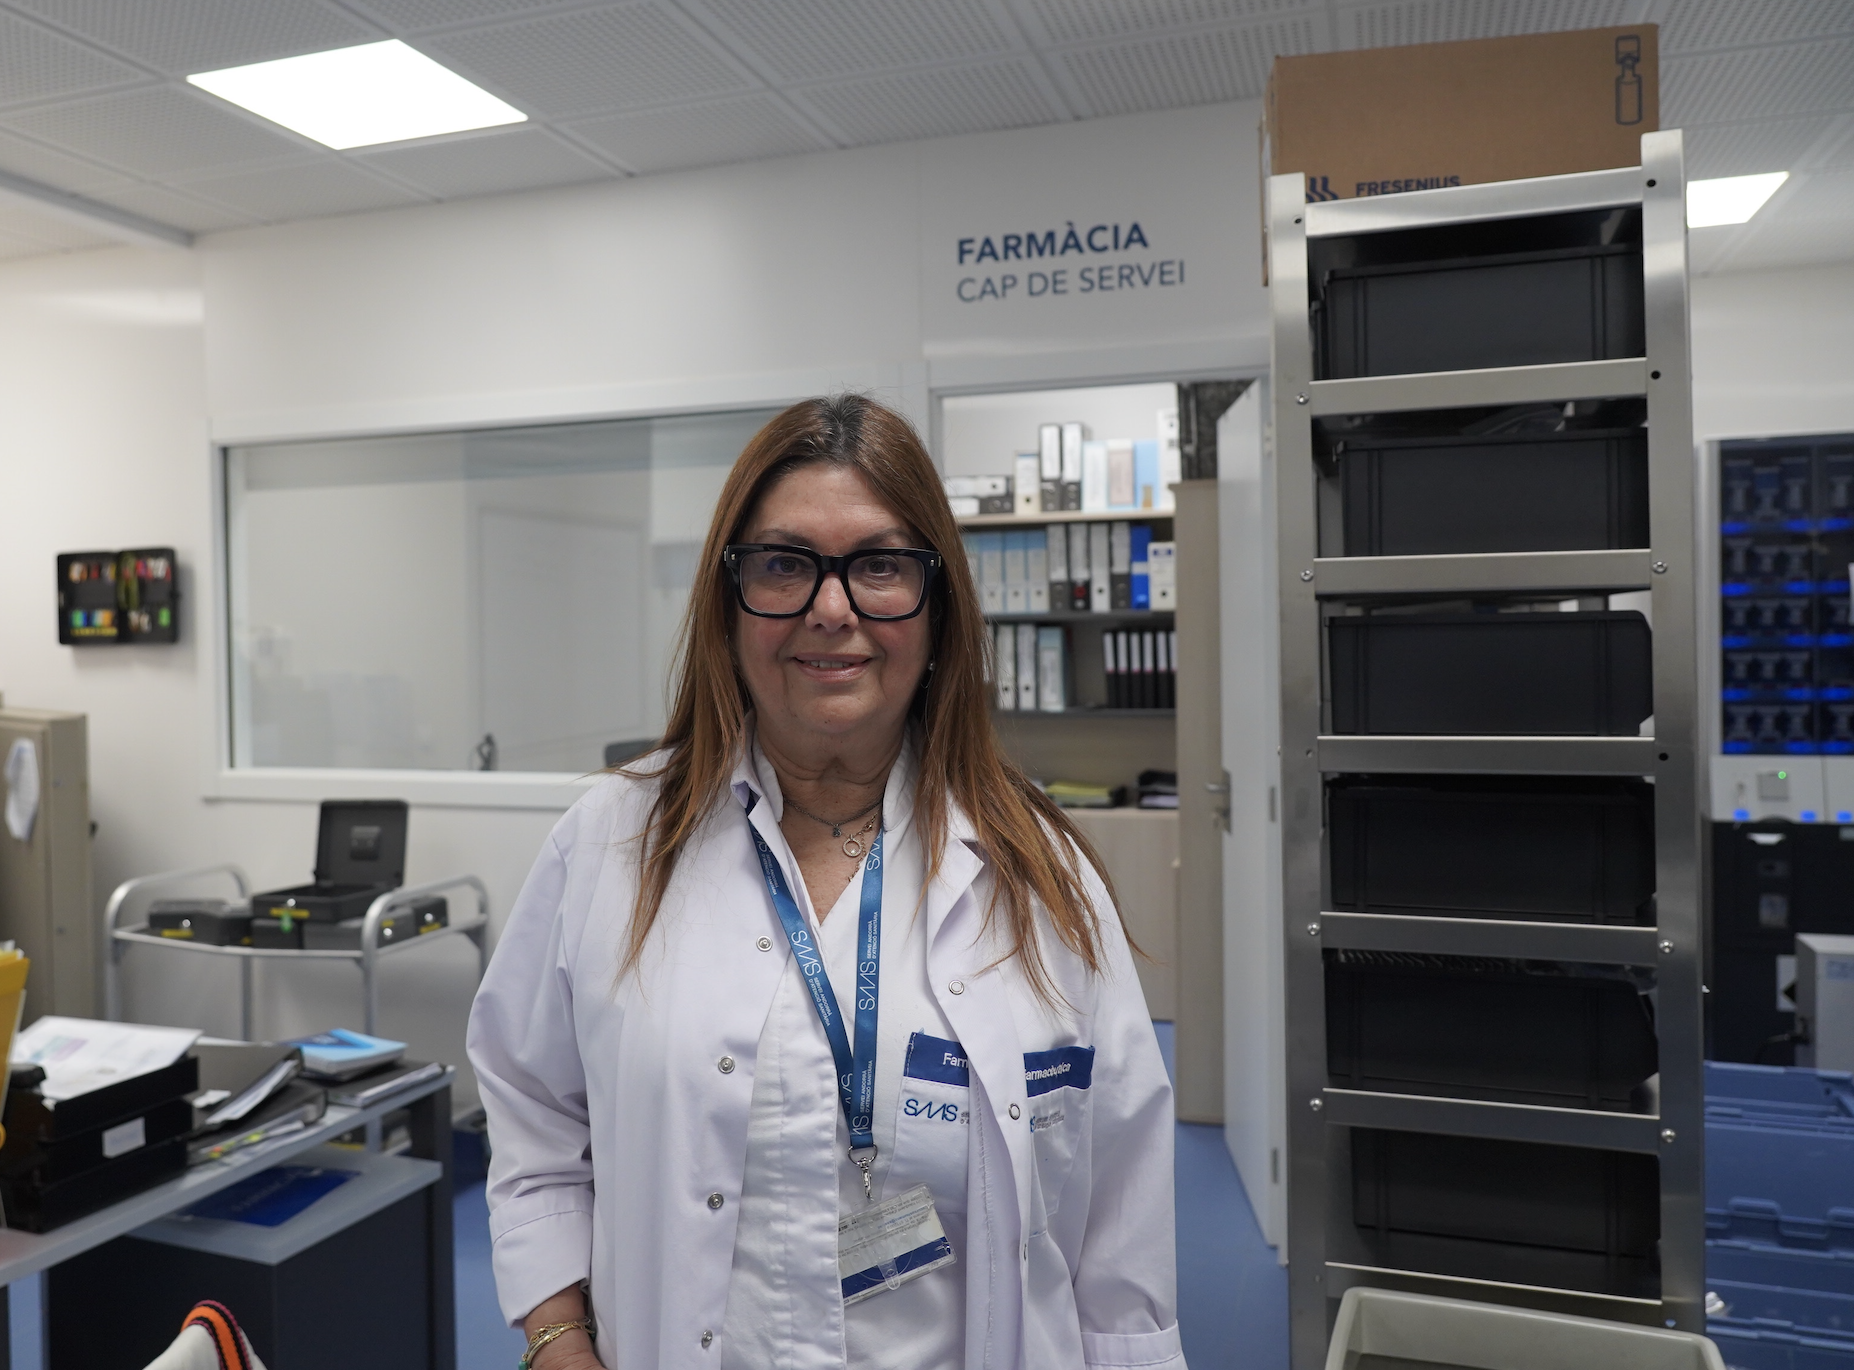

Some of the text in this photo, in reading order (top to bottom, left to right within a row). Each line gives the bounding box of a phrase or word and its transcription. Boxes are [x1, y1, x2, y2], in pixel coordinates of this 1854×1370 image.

[1356, 175, 1461, 197] FRESENIUS
[957, 221, 1149, 265] FARMÀCIA
[957, 259, 1186, 303] CAP DE SERVEI
